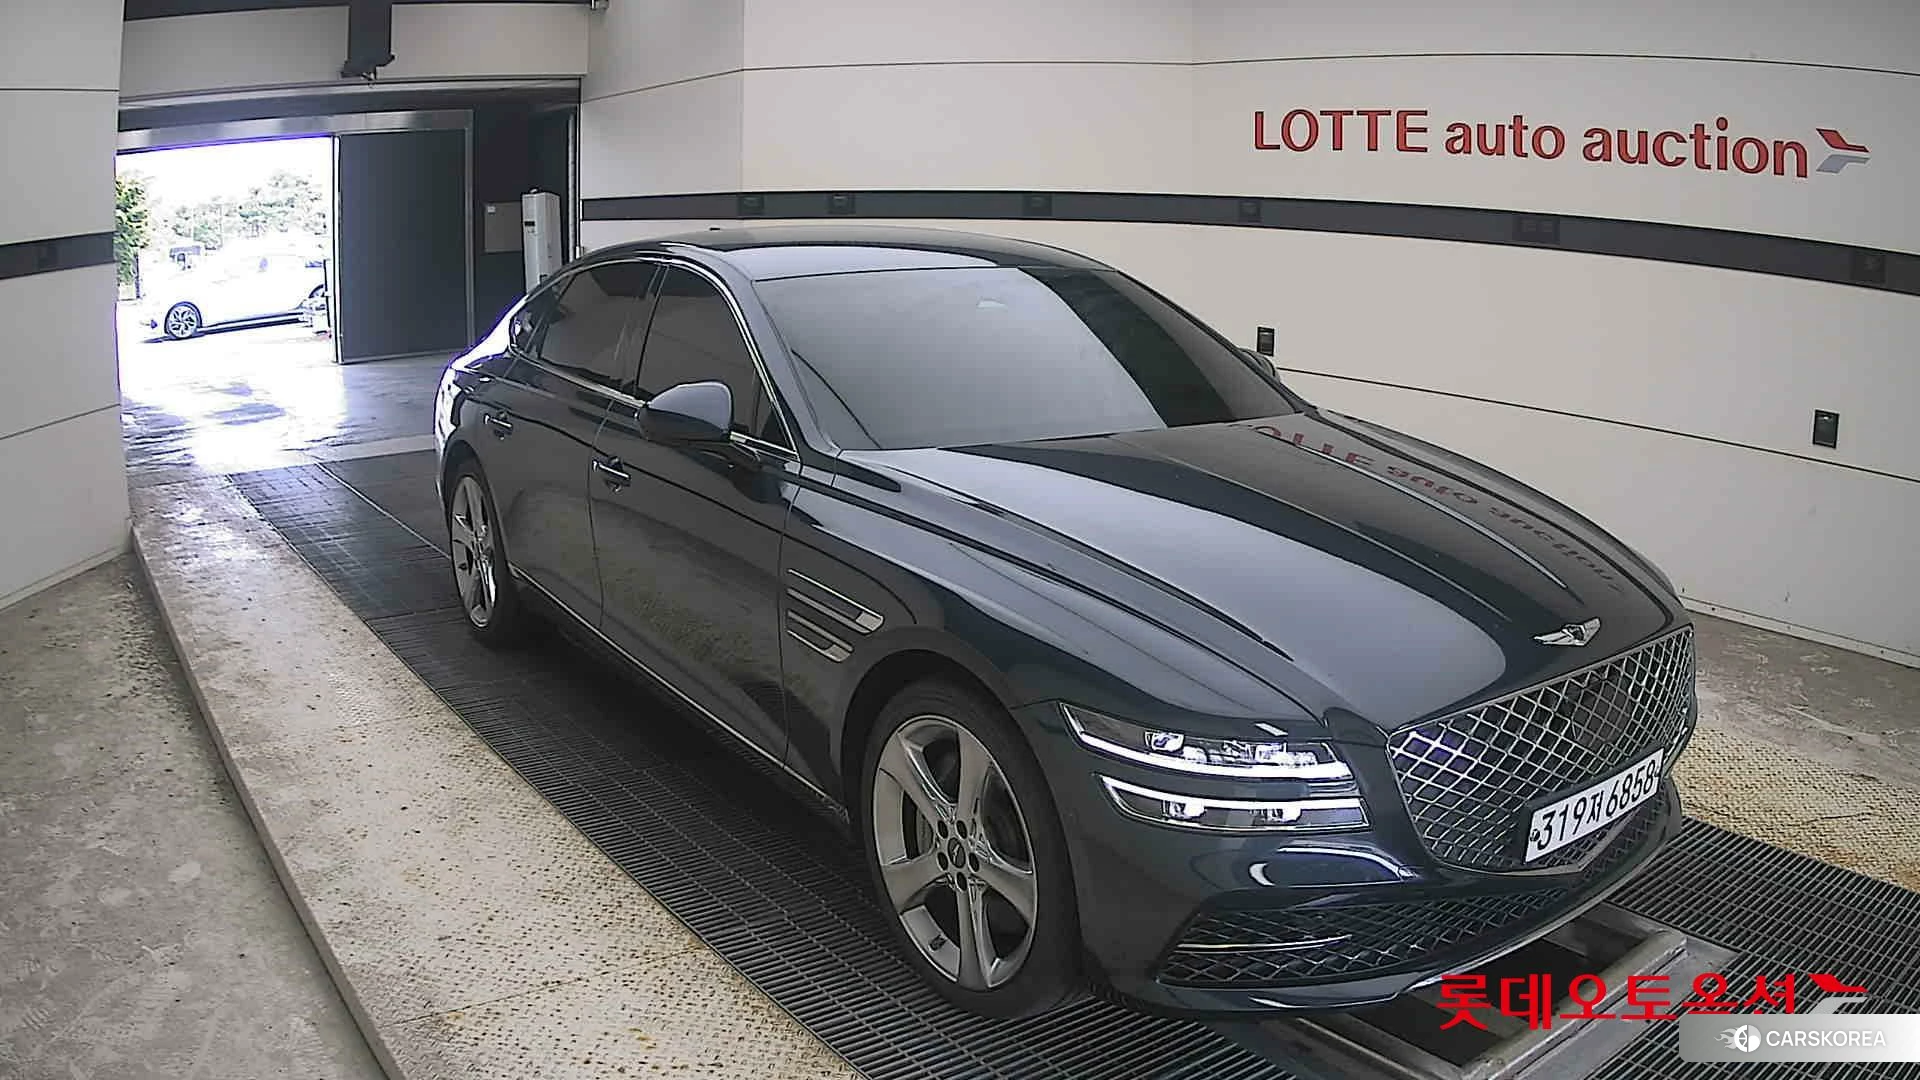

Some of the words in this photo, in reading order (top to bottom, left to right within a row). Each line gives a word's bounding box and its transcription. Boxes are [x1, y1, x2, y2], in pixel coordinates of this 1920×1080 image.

[1253, 108, 1429, 154] LOTTE
[1444, 114, 1567, 161] auto
[1582, 116, 1809, 179] auction
